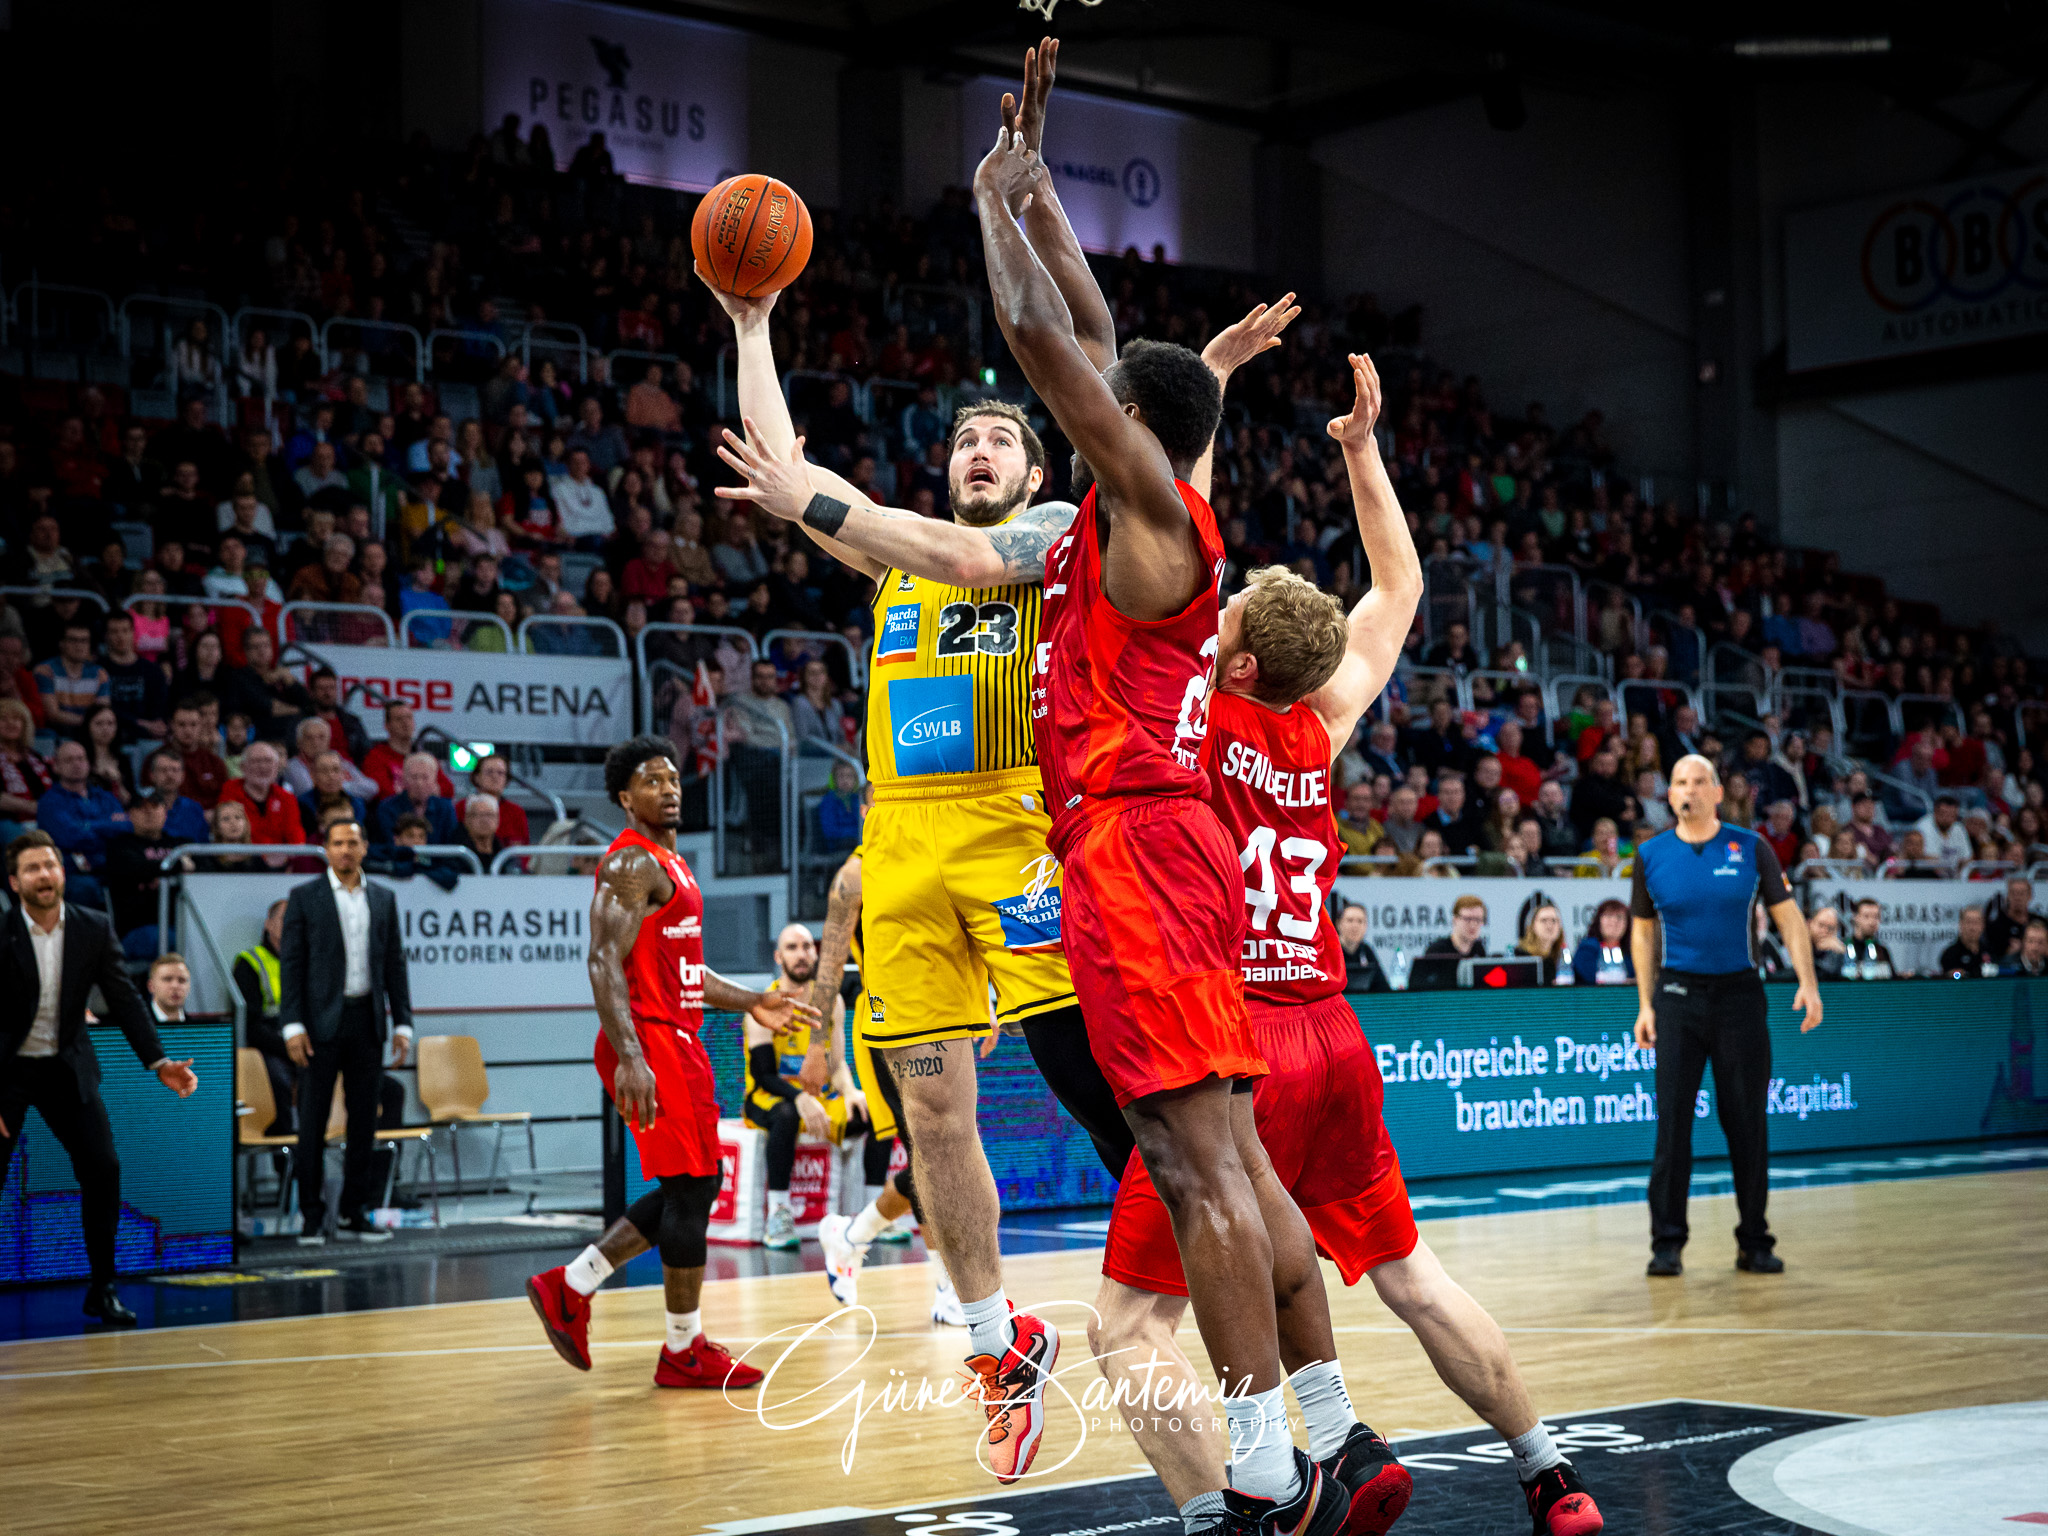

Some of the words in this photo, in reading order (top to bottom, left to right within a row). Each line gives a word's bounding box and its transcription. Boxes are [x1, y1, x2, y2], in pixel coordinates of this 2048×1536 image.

[529, 77, 706, 141] PEGASUS
[724, 187, 755, 254] LEGACY
[747, 190, 788, 270] SPALDING
[889, 620, 917, 633] Bank
[900, 636, 915, 646] BW
[937, 601, 1019, 657] 23
[465, 681, 612, 717] ARENA
[913, 720, 961, 739] SWLB
[1239, 825, 1328, 941] 43
[406, 909, 582, 937] IGARASHI
[404, 944, 513, 964] MOTOREN
[519, 944, 582, 963] GMBH
[1374, 1036, 1549, 1088] Erfolgreiche
[1455, 1087, 1587, 1131] brauchen
[1767, 1072, 1858, 1121] Kapital.
